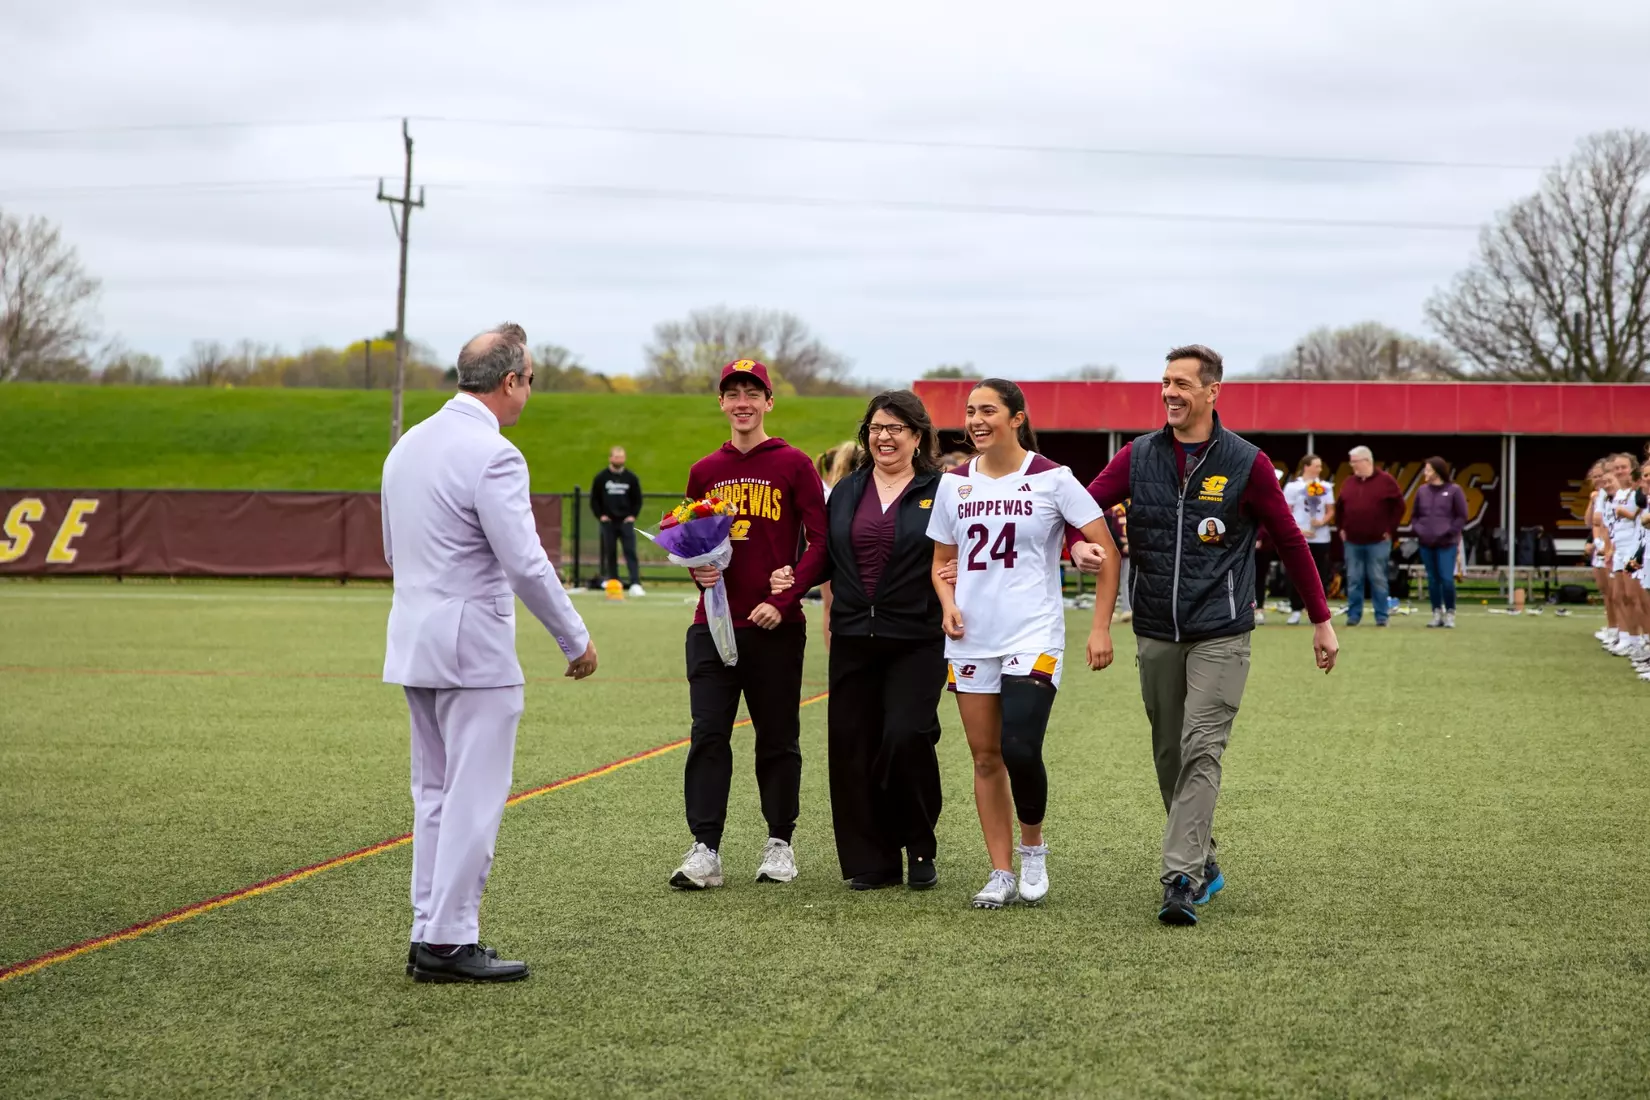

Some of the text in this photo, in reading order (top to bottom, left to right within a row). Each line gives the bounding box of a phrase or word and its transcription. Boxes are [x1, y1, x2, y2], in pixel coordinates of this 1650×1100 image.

[714, 479, 738, 488] CENTRAL
[705, 483, 782, 521] PPEWAS
[958, 500, 1033, 519] CHIPPEWAS
[967, 522, 1018, 571] 24
